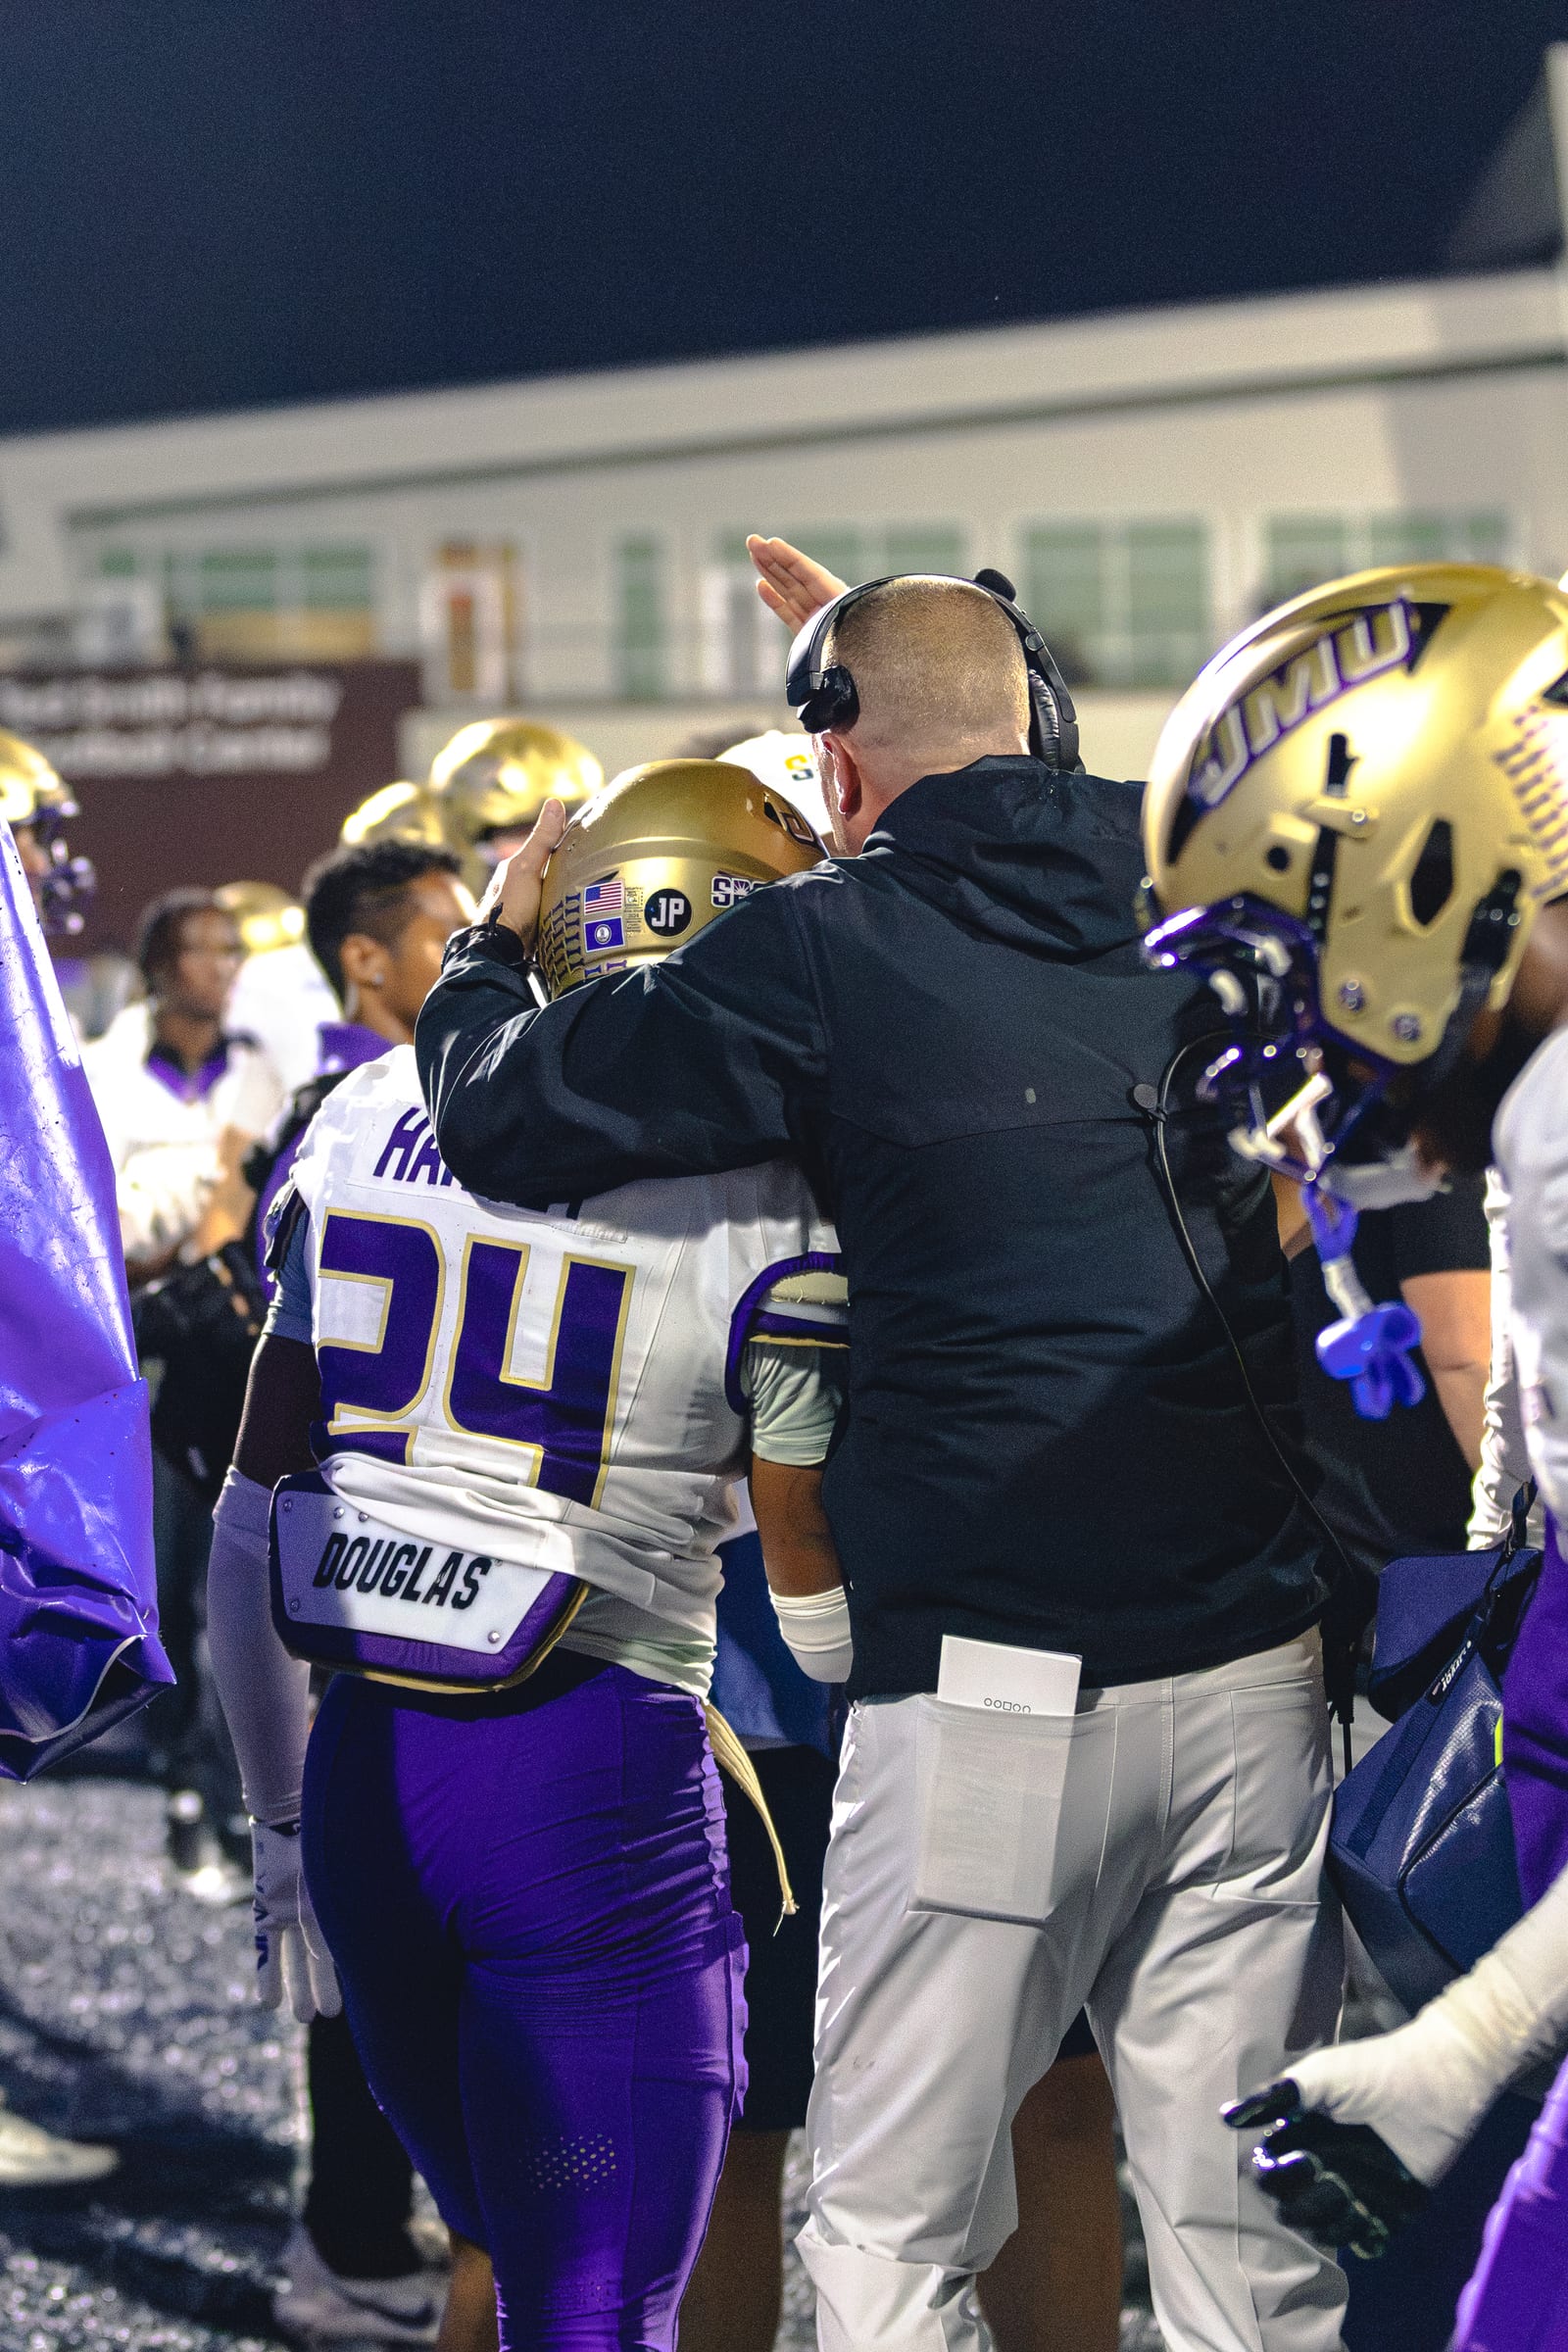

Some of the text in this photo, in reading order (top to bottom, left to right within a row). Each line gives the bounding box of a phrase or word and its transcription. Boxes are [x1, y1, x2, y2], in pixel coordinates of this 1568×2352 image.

[1186, 596, 1413, 811] JMU
[651, 897, 685, 928] JP
[318, 1206, 637, 1510] 24
[312, 1532, 493, 1610] DOUGLAS
